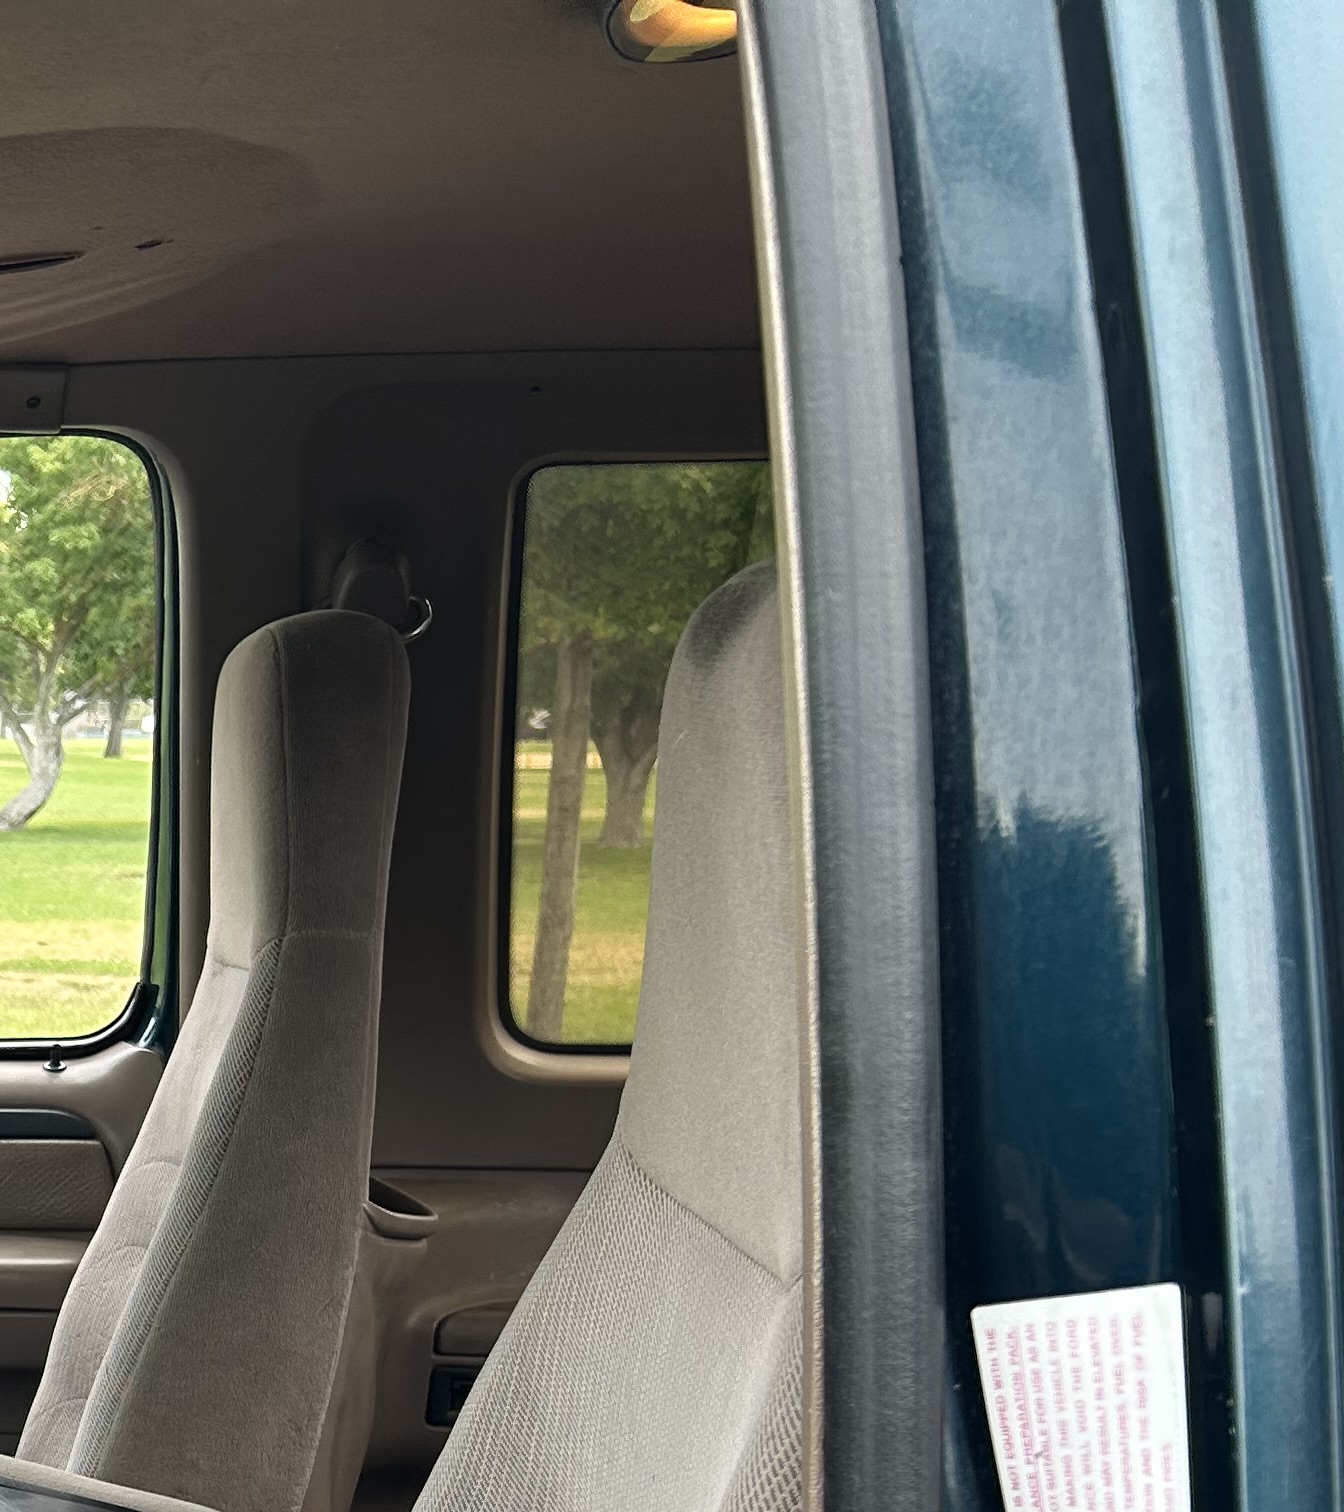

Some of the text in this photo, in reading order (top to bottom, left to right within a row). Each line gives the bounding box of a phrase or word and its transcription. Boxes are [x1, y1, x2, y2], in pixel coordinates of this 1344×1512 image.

[984, 1328, 996, 1350] THE
[1023, 1323, 1035, 1340] AN
[1044, 1321, 1056, 1351] INTO
[1064, 1319, 1078, 1356] FORD
[1026, 1346, 1038, 1362] AS
[1086, 1316, 1102, 1382] ELEVATED
[990, 1358, 1003, 1389] WITH
[1029, 1368, 1042, 1392] USE
[1049, 1359, 1064, 1411] VEHICLE
[1070, 1367, 1082, 1391] THE
[1112, 1363, 1125, 1393] FUEL
[1093, 1387, 1104, 1399] IN
[1011, 1372, 1034, 1464] PREPARATION
[1034, 1398, 1047, 1423] FOR
[1074, 1399, 1087, 1431] VOID
[996, 1396, 1014, 1458] EQUIPPED
[1057, 1420, 1068, 1445] THIS
[1095, 1405, 1109, 1454] RESULT
[1138, 1416, 1149, 1439] THE
[1038, 1428, 1056, 1488] SUITABLE
[1079, 1441, 1091, 1474] WILL
[1140, 1448, 1151, 1475] AND
[1008, 1466, 1019, 1489] NOT
[1061, 1455, 1076, 1505] MAKING
[1101, 1461, 1112, 1486] MAY
[1013, 1495, 1022, 1506] IS
